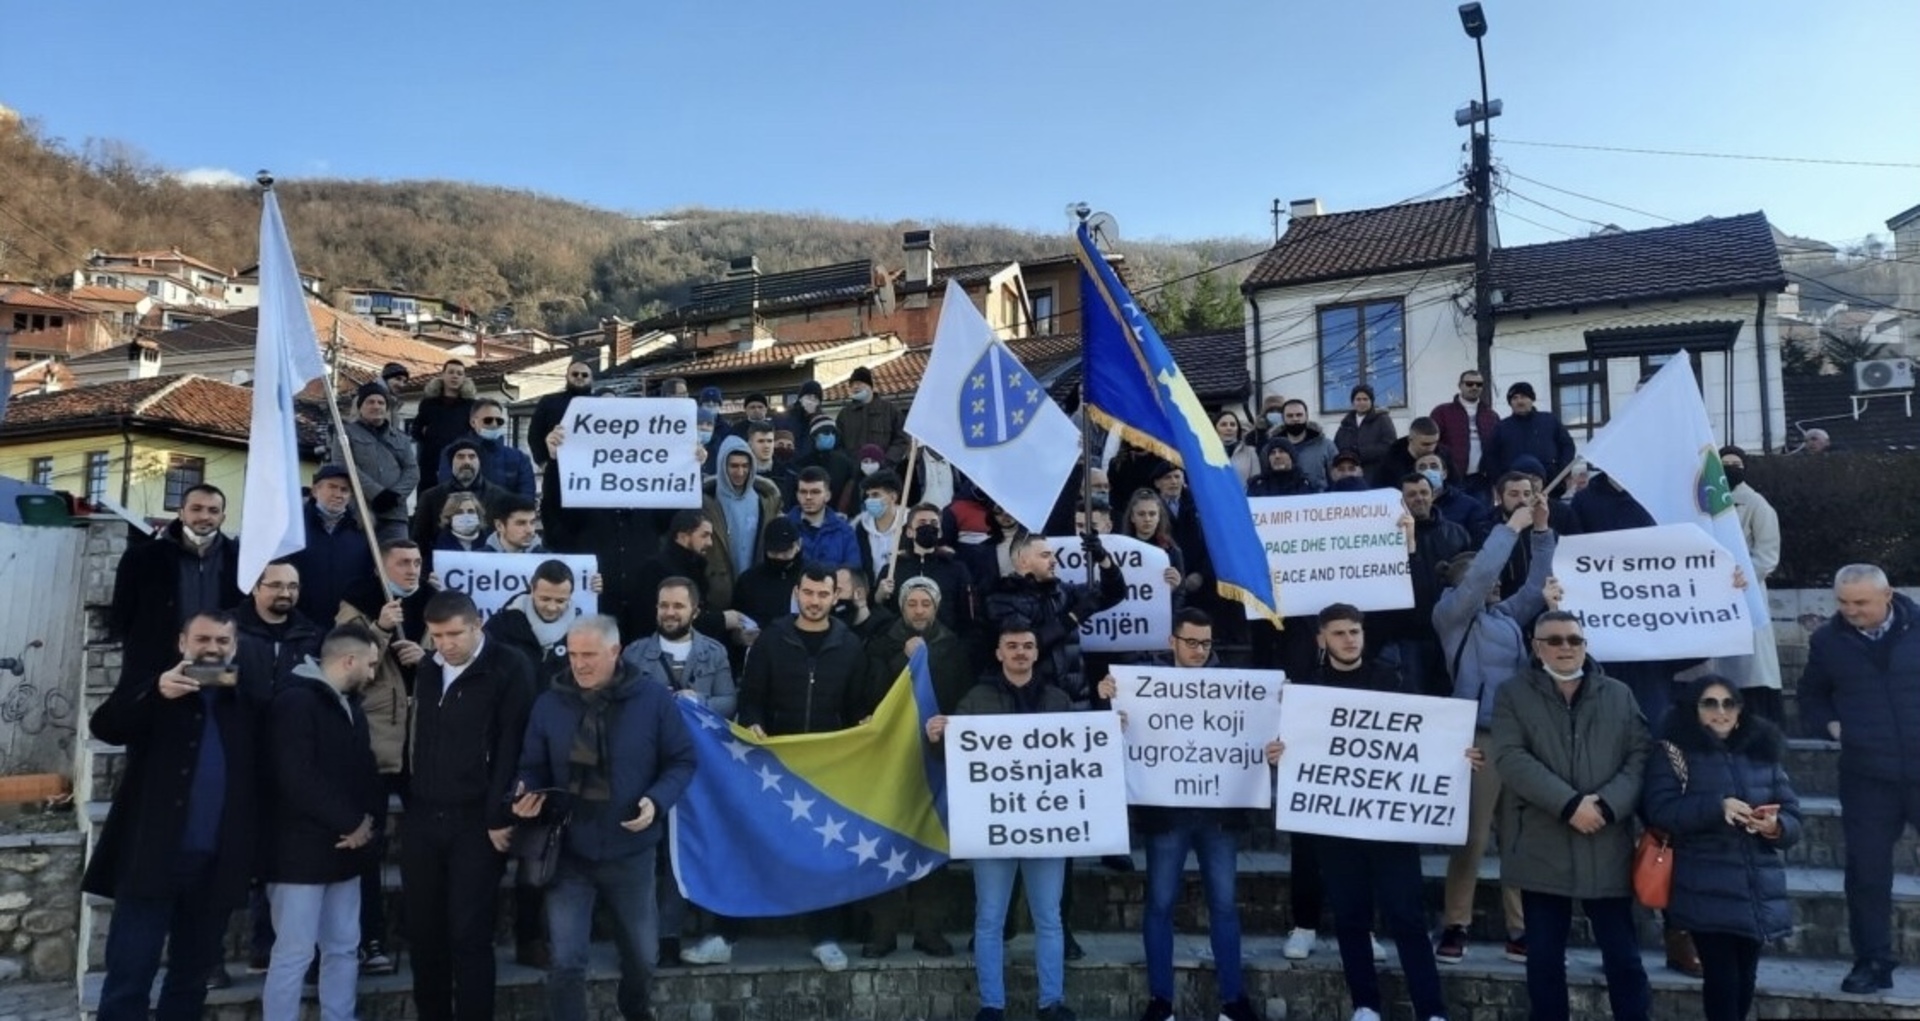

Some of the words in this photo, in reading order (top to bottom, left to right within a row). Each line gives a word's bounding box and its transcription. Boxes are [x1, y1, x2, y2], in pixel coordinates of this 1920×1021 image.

[573, 414, 640, 440] Keep
[649, 414, 687, 435] the
[593, 446, 669, 468] peace
[568, 473, 591, 492] in
[601, 473, 695, 492] Bosnia!
[1253, 512, 1268, 527] ZA
[1270, 510, 1292, 525] MIR
[1296, 510, 1300, 523] I
[1303, 503, 1391, 523] TOLERANCIJU,
[1054, 546, 1143, 569] Kova
[1265, 540, 1298, 555] PAQE
[1301, 537, 1326, 553] DHE
[1575, 554, 1614, 573] Svi
[1622, 556, 1676, 571] smo
[1685, 550, 1716, 569] mi
[582, 570, 588, 591] i
[1274, 569, 1306, 585] EACE
[1309, 565, 1335, 581] AND
[1601, 581, 1681, 600] Bosna
[1689, 578, 1696, 597] i
[1080, 612, 1149, 641] snjën
[1135, 675, 1267, 701] Zaustavite
[1148, 712, 1194, 731] one
[1203, 710, 1245, 738] koji
[1330, 707, 1424, 734] BIZLER
[960, 730, 1012, 751] Sve
[1023, 727, 1075, 749] dok
[1084, 726, 1108, 752] je
[1328, 736, 1420, 763] BOSNA
[1128, 739, 1264, 770] ugrožavaju
[969, 758, 1103, 785] Bošnjaka
[1296, 762, 1403, 792] HERSEK
[1409, 773, 1451, 796] ILE
[1174, 774, 1220, 796] mir!
[990, 792, 1026, 814] bit
[1036, 789, 1068, 812] će
[1079, 789, 1085, 810] i
[1289, 791, 1456, 827] BIRLIKTEYIZ!
[988, 820, 1090, 845] Bosne!
